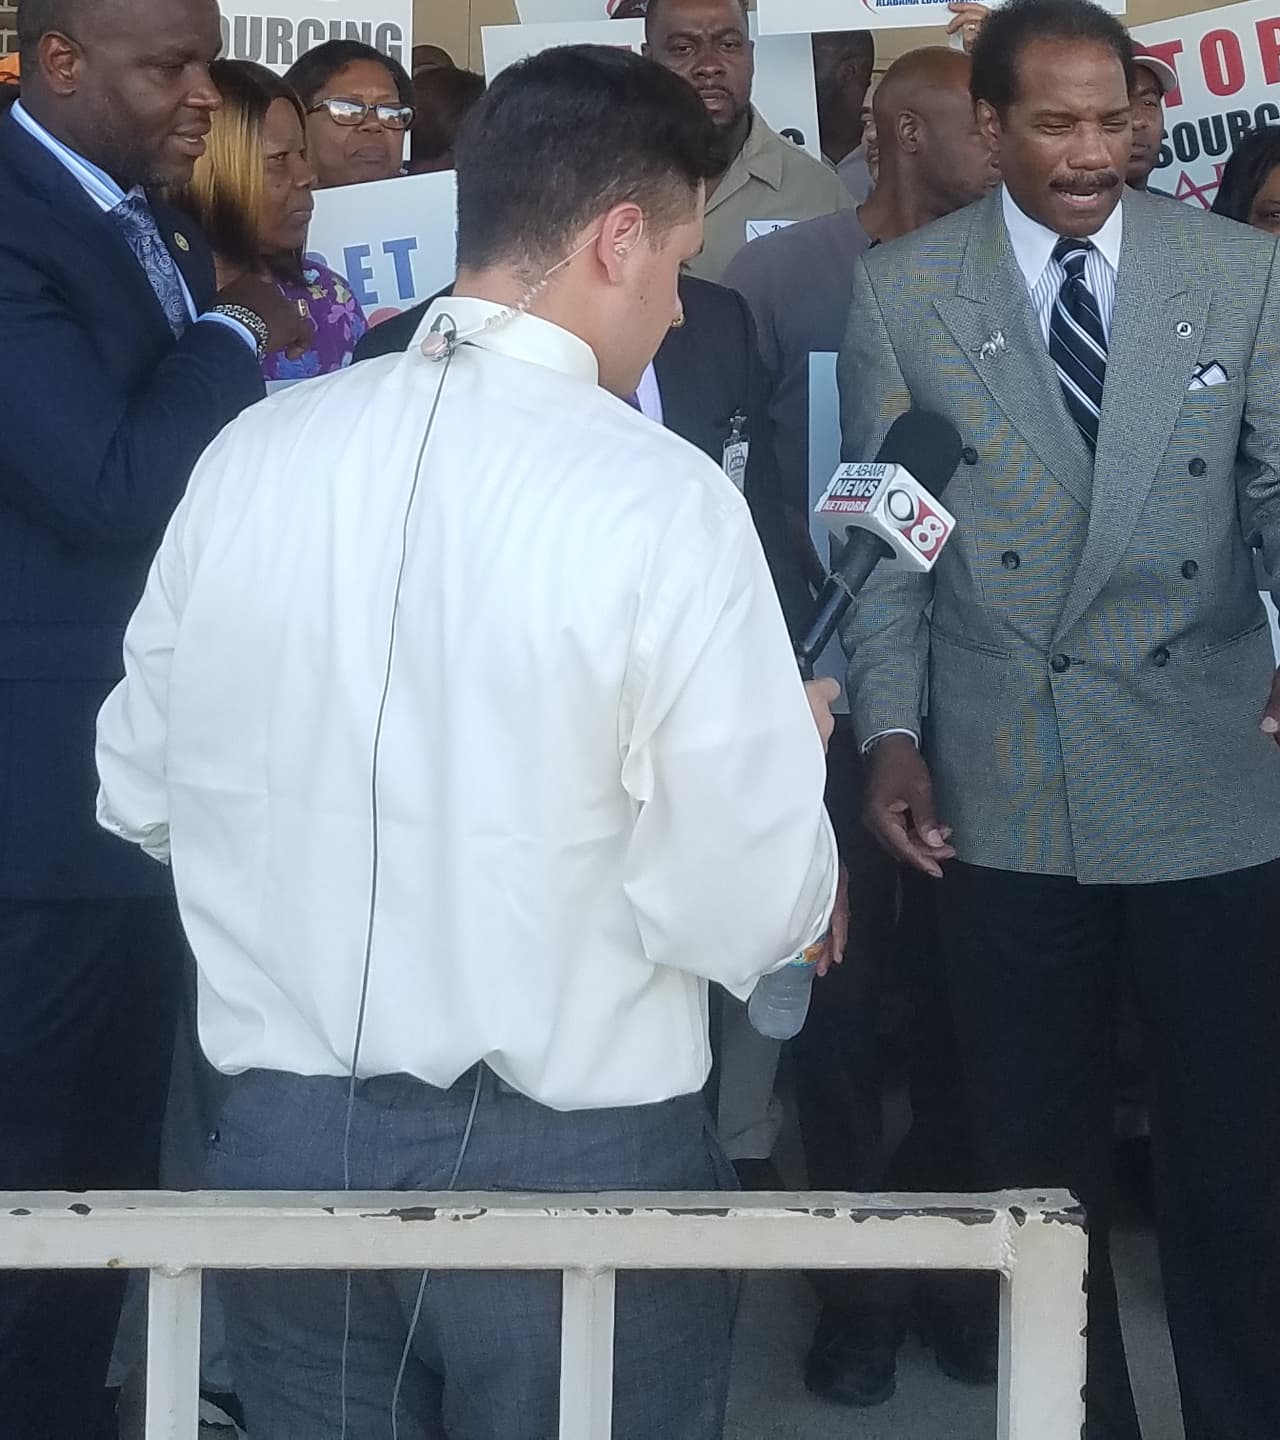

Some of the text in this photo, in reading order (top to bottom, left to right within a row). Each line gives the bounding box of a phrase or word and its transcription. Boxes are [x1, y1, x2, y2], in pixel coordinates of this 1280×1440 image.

[304, 236, 418, 306] ET
[841, 464, 887, 477] ALABAMA
[832, 479, 879, 497] NEWS
[822, 501, 869, 512] NETWORK
[910, 515, 945, 552] 8
